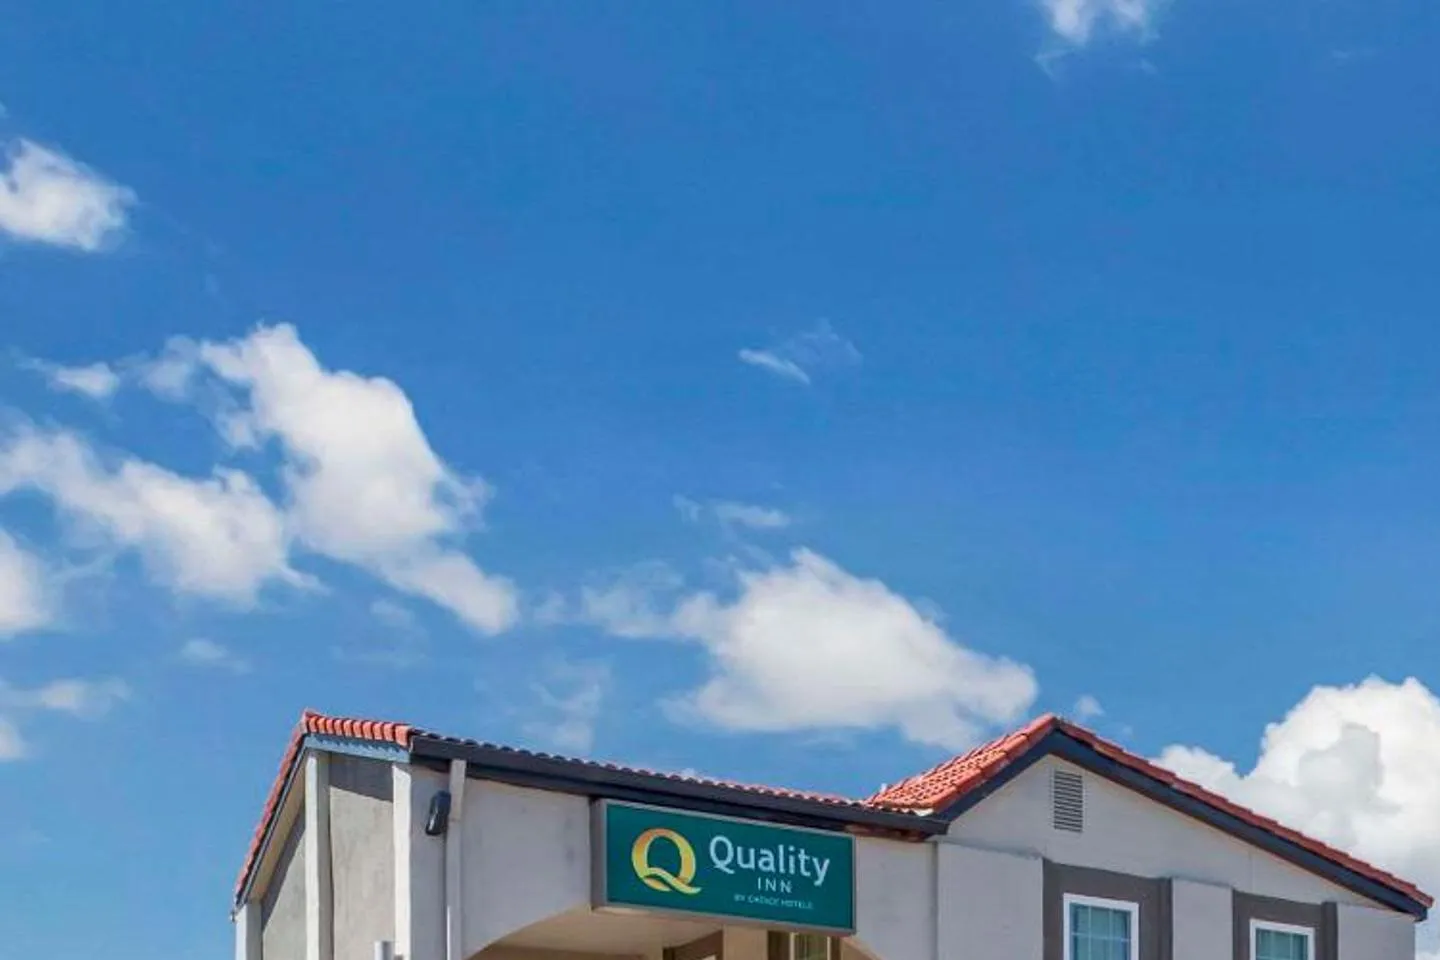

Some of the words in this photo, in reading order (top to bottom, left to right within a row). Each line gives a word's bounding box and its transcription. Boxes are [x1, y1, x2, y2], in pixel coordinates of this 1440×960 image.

[631, 828, 702, 894] Q
[709, 835, 830, 886] Quality
[757, 877, 792, 893] INN
